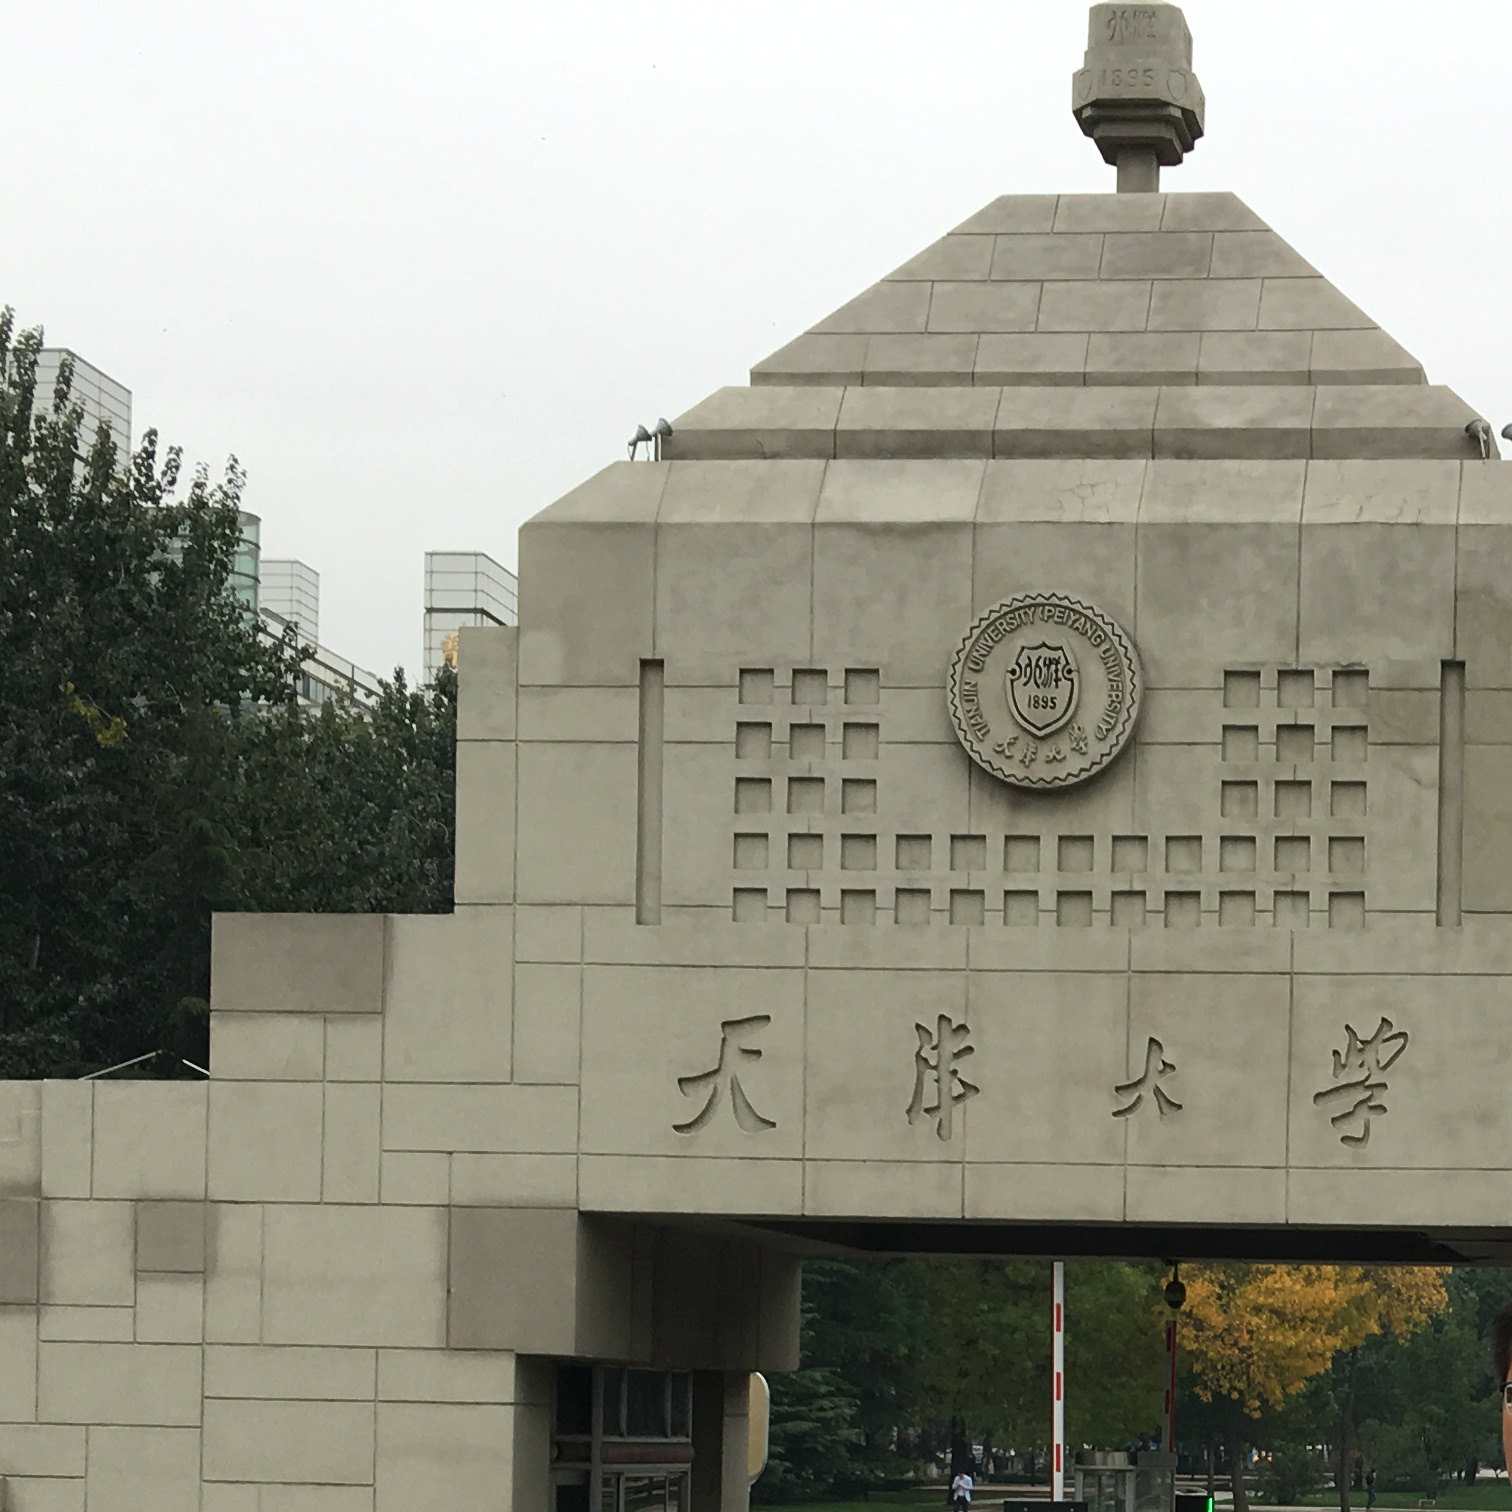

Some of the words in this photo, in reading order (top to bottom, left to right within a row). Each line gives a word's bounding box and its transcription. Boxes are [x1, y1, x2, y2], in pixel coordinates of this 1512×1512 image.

[968, 606, 1037, 674] UNIVERSITY
[1027, 694, 1058, 710] 1895
[672, 1013, 1409, 1148] 天津大学
